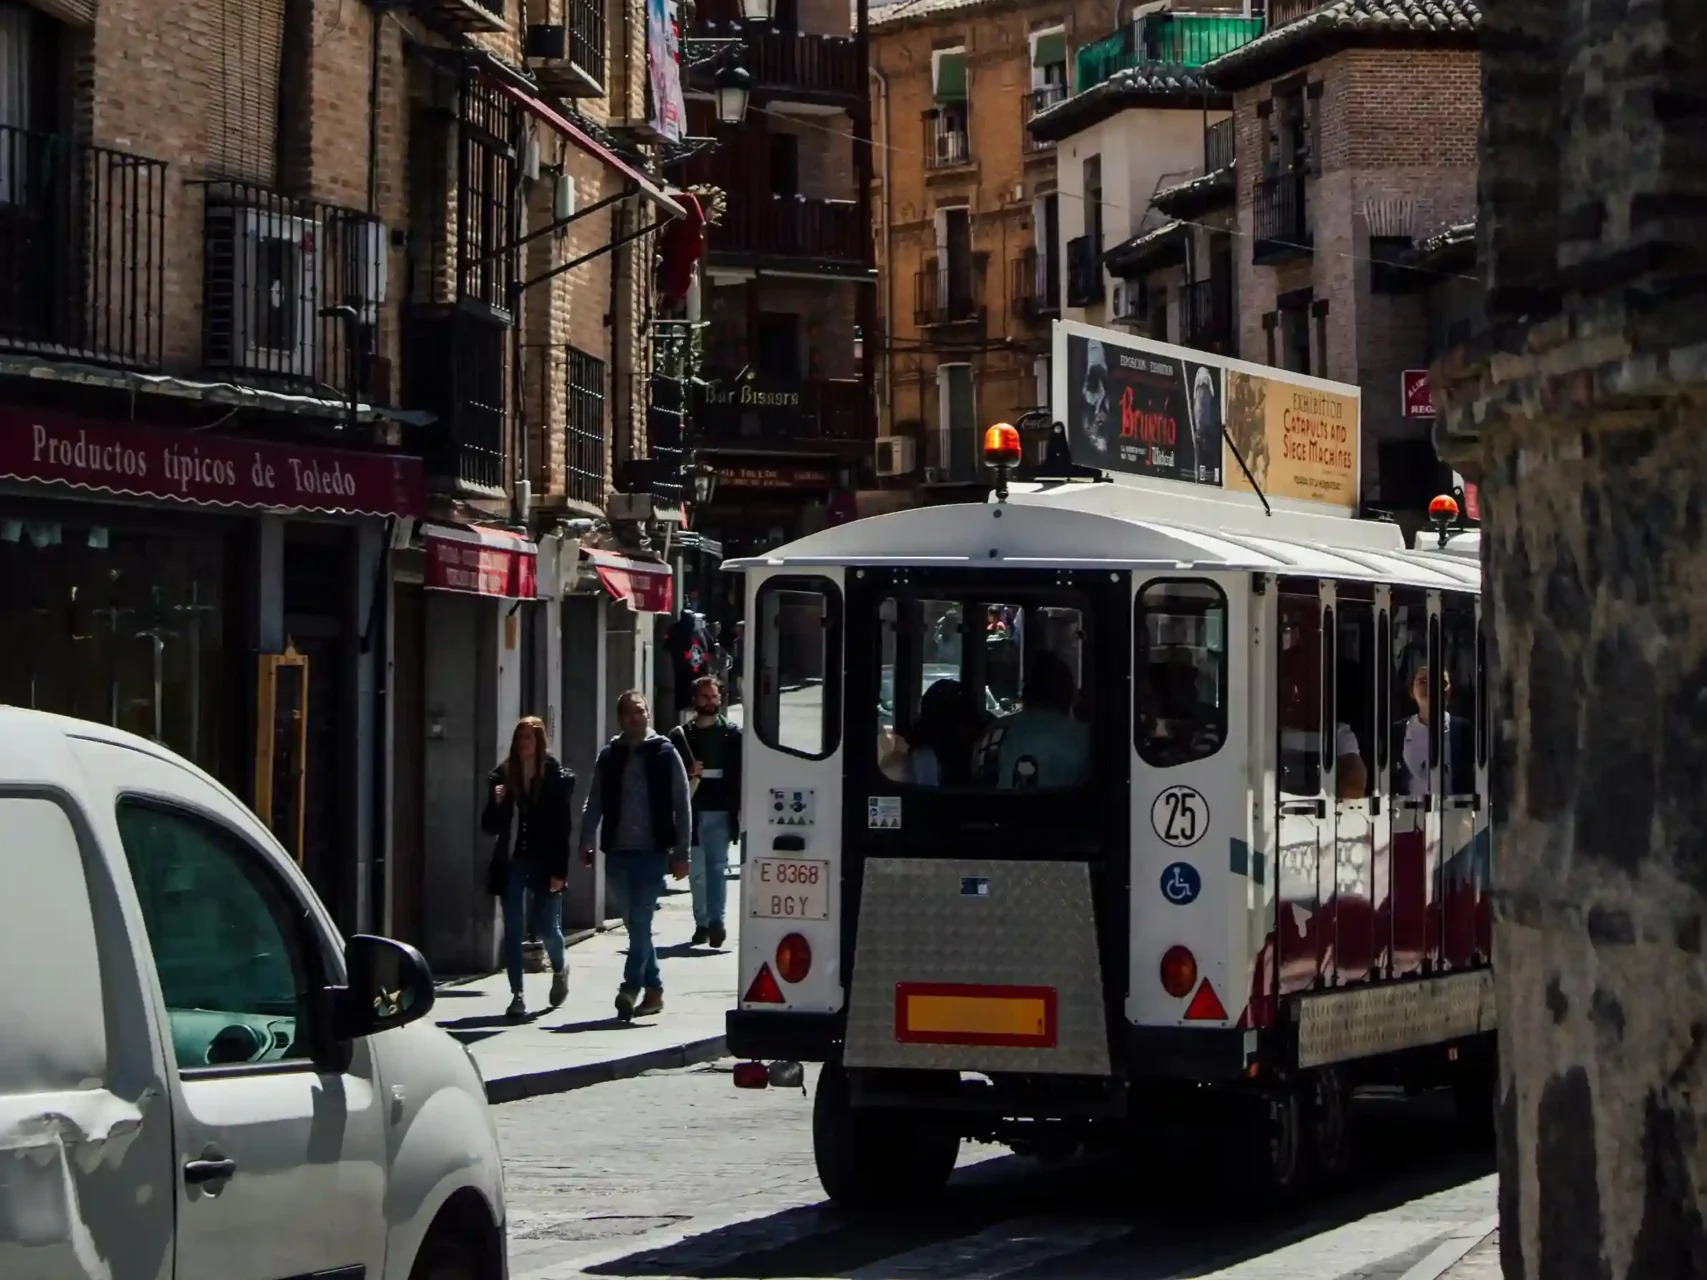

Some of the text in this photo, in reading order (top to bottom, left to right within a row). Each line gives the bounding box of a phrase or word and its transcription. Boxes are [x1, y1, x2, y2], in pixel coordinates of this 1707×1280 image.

[704, 384, 801, 406] Bar Bisagra
[32, 424, 357, 498] Productos típicos de Toledo
[1164, 792, 1196, 841] 25
[761, 863, 820, 885] E 8368
